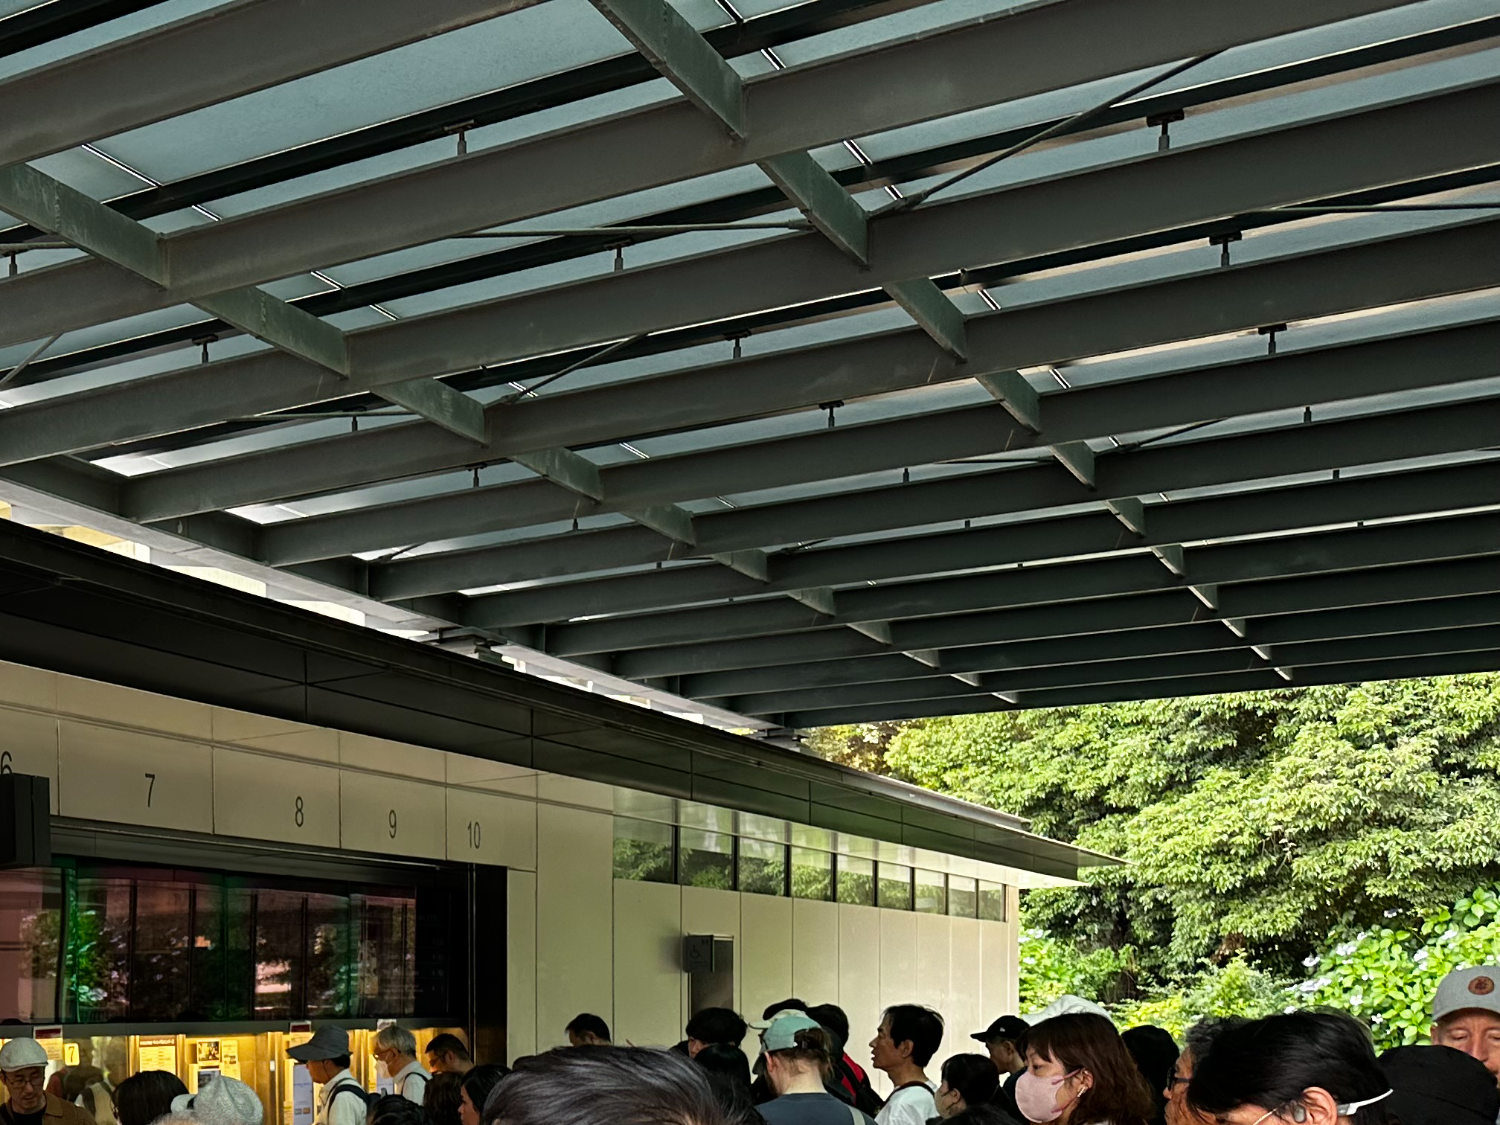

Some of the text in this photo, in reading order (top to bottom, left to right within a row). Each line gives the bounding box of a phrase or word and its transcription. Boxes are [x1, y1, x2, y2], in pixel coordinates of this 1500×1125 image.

[0, 750, 13, 774] 6
[144, 772, 156, 808] 7
[294, 795, 304, 828] 8
[388, 809, 397, 840] 9
[467, 820, 481, 850] 10
[67, 1045, 76, 1063] 7
